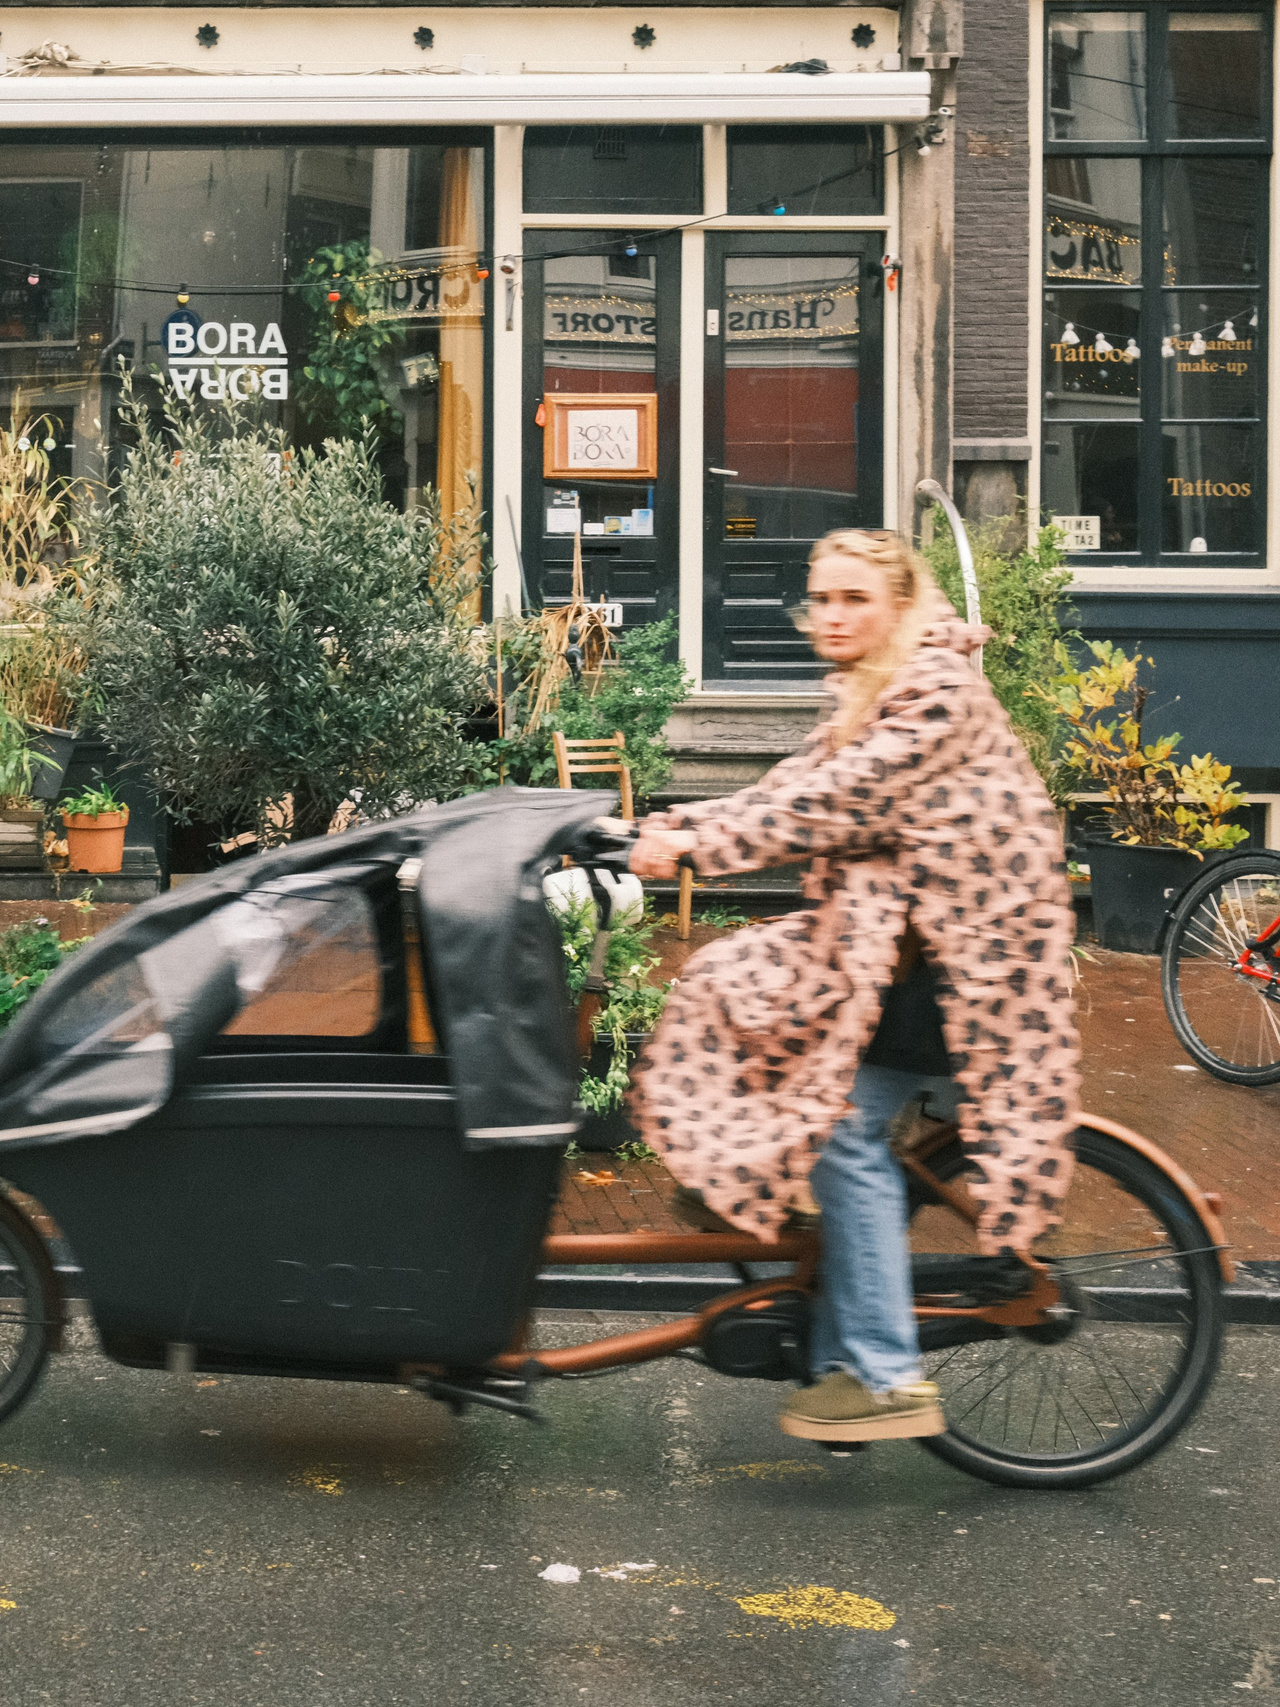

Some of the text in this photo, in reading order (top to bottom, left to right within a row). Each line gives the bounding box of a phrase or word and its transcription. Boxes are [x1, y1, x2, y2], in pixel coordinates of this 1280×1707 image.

[167, 321, 288, 355] BORA
[1169, 336, 1253, 351] Peranent
[1176, 358, 1249, 377] make-up
[168, 368, 288, 400] BORA
[1167, 477, 1252, 497] Tattoos
[1061, 520, 1091, 531] TIME
[586, 606, 616, 624] 61
